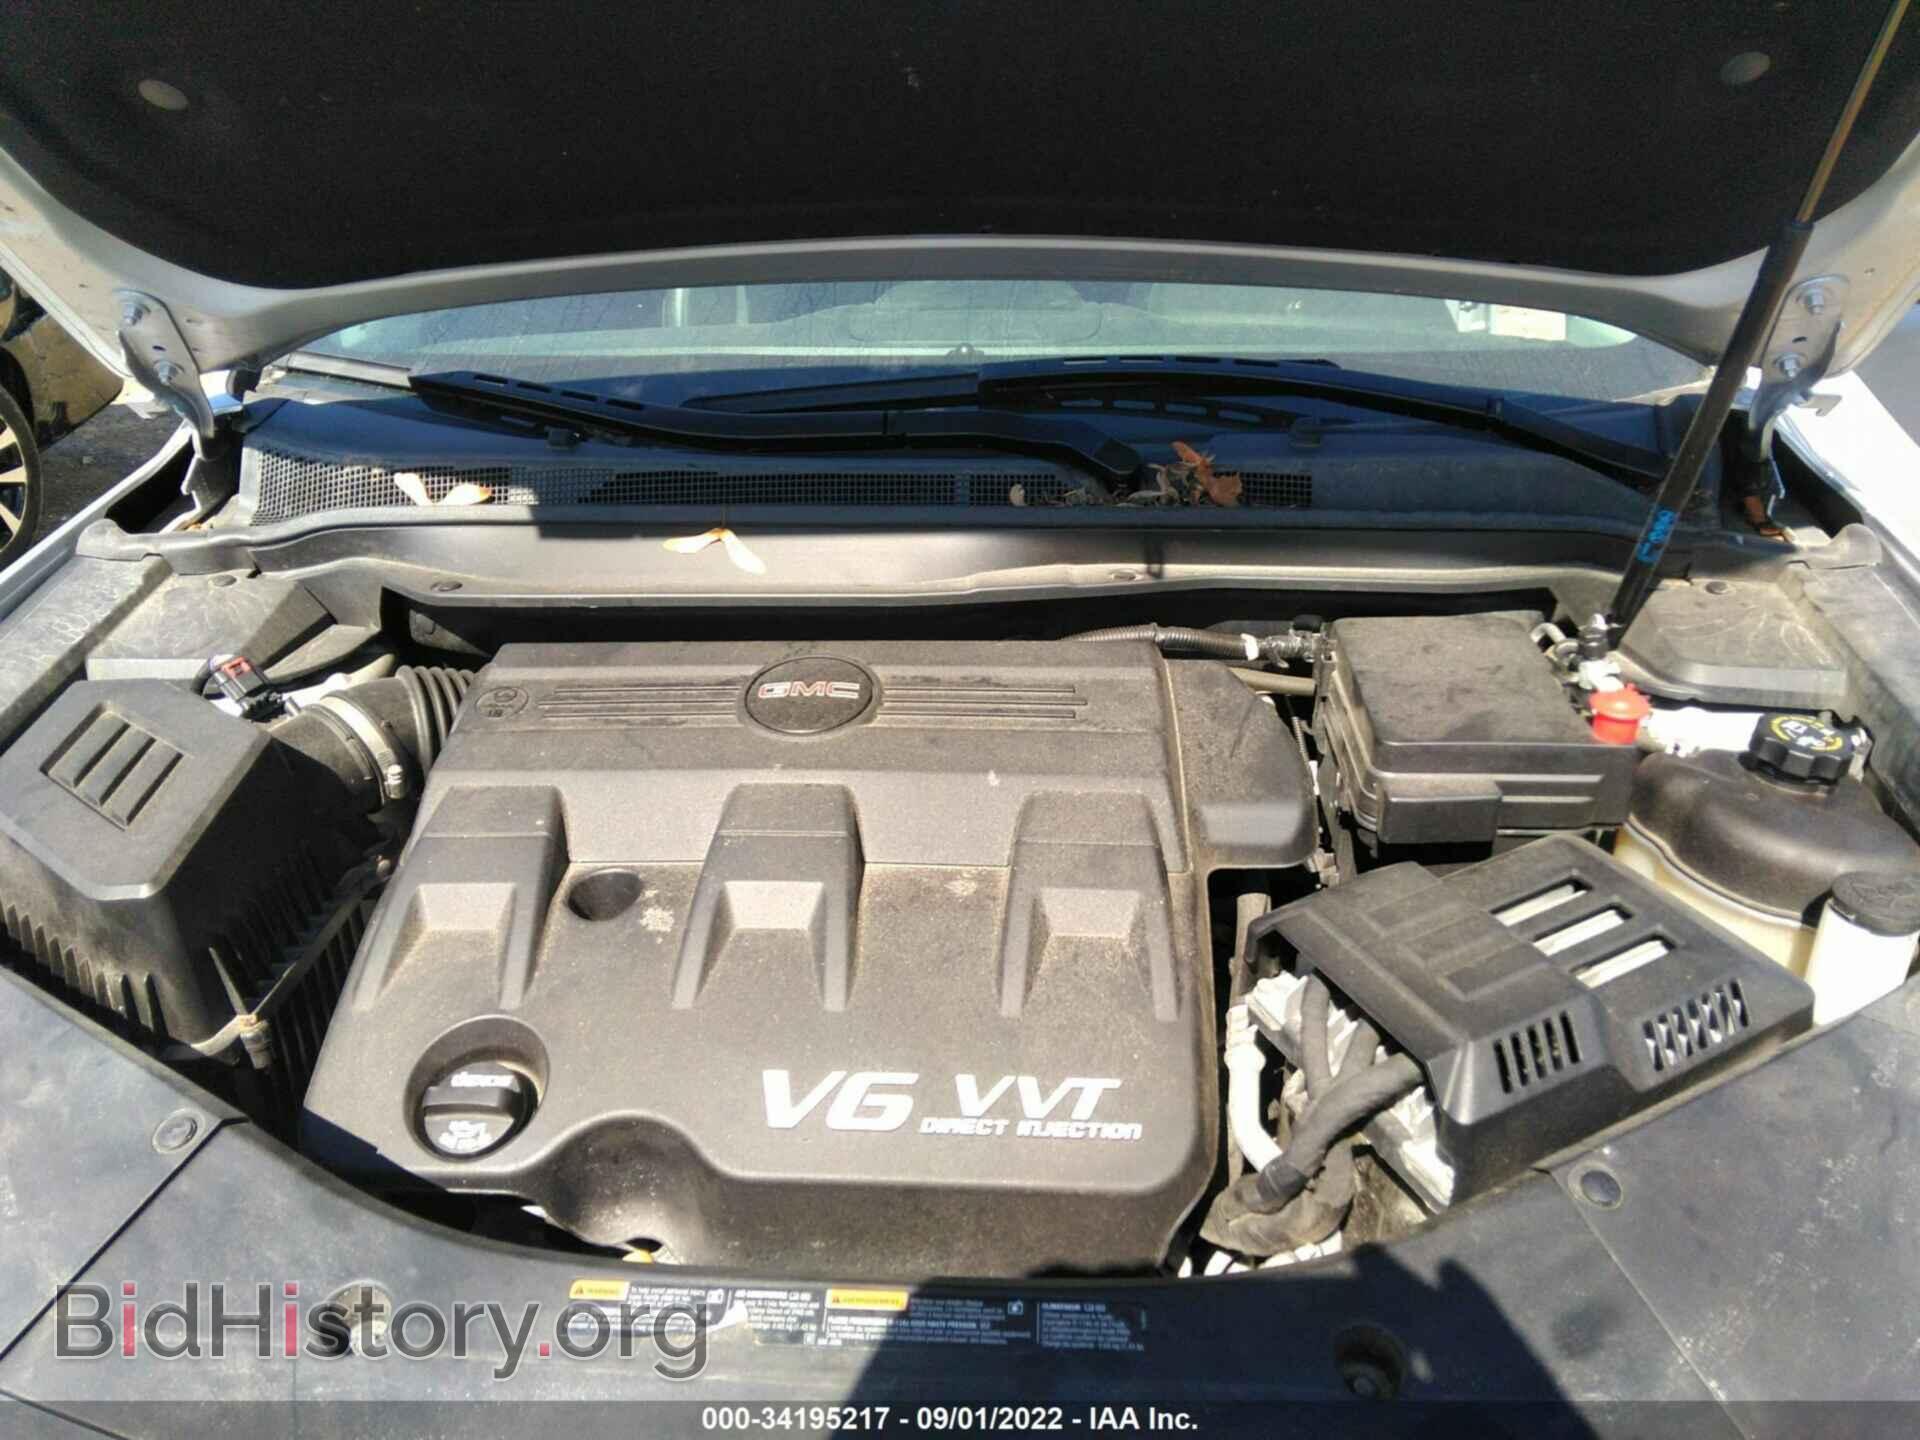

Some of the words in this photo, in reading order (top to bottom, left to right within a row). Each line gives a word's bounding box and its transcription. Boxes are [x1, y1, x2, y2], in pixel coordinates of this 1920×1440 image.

[758, 680, 861, 699] GMC
[762, 1069, 920, 1132] V6
[954, 1073, 1123, 1121] VVT
[919, 1116, 1010, 1136] DIRECT
[1015, 1118, 1144, 1140] INJECTION
